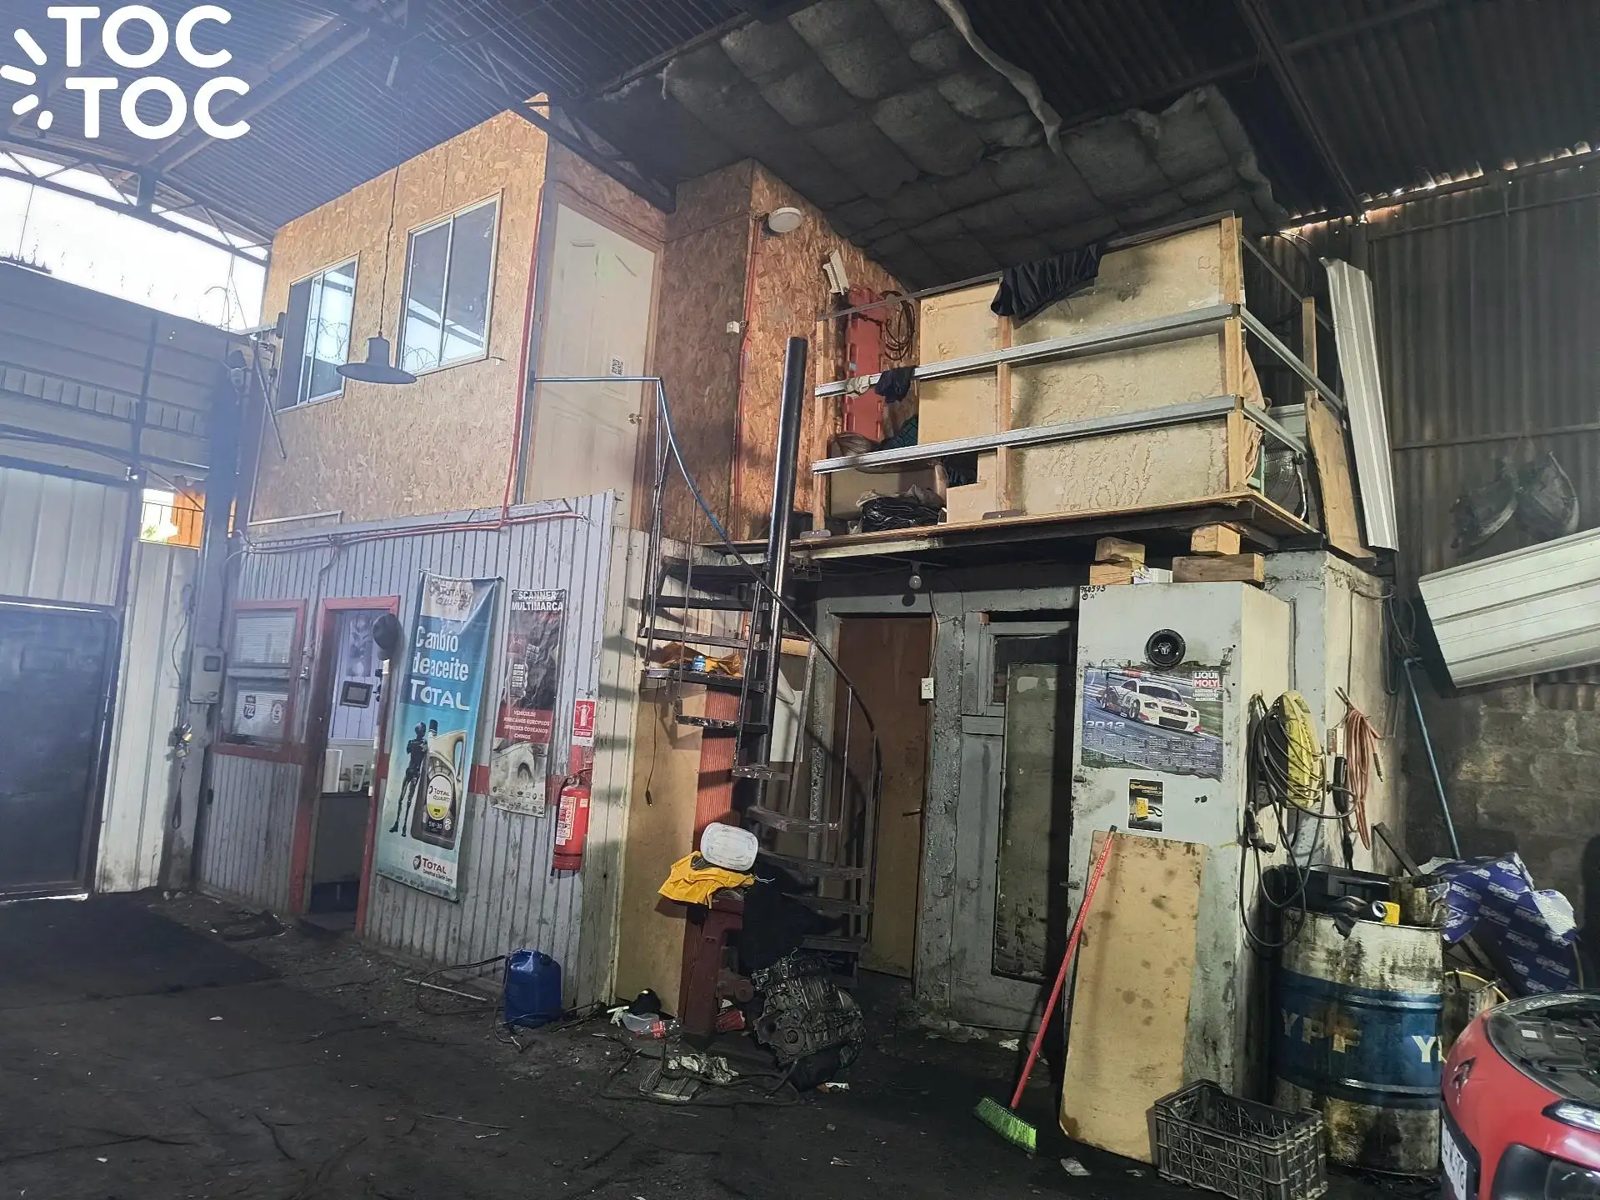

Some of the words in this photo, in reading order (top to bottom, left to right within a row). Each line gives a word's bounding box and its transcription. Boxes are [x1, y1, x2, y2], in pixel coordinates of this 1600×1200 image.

[518, 591, 557, 601] SCANNER
[511, 601, 564, 612] MULTIMARCA
[416, 625, 459, 653] Cambio
[1194, 671, 1218, 679] LIQUI
[1194, 680, 1218, 688] MOLY
[411, 679, 470, 711] TOTAL
[434, 787, 450, 796] TOTAL
[422, 857, 447, 875] TOTAL
